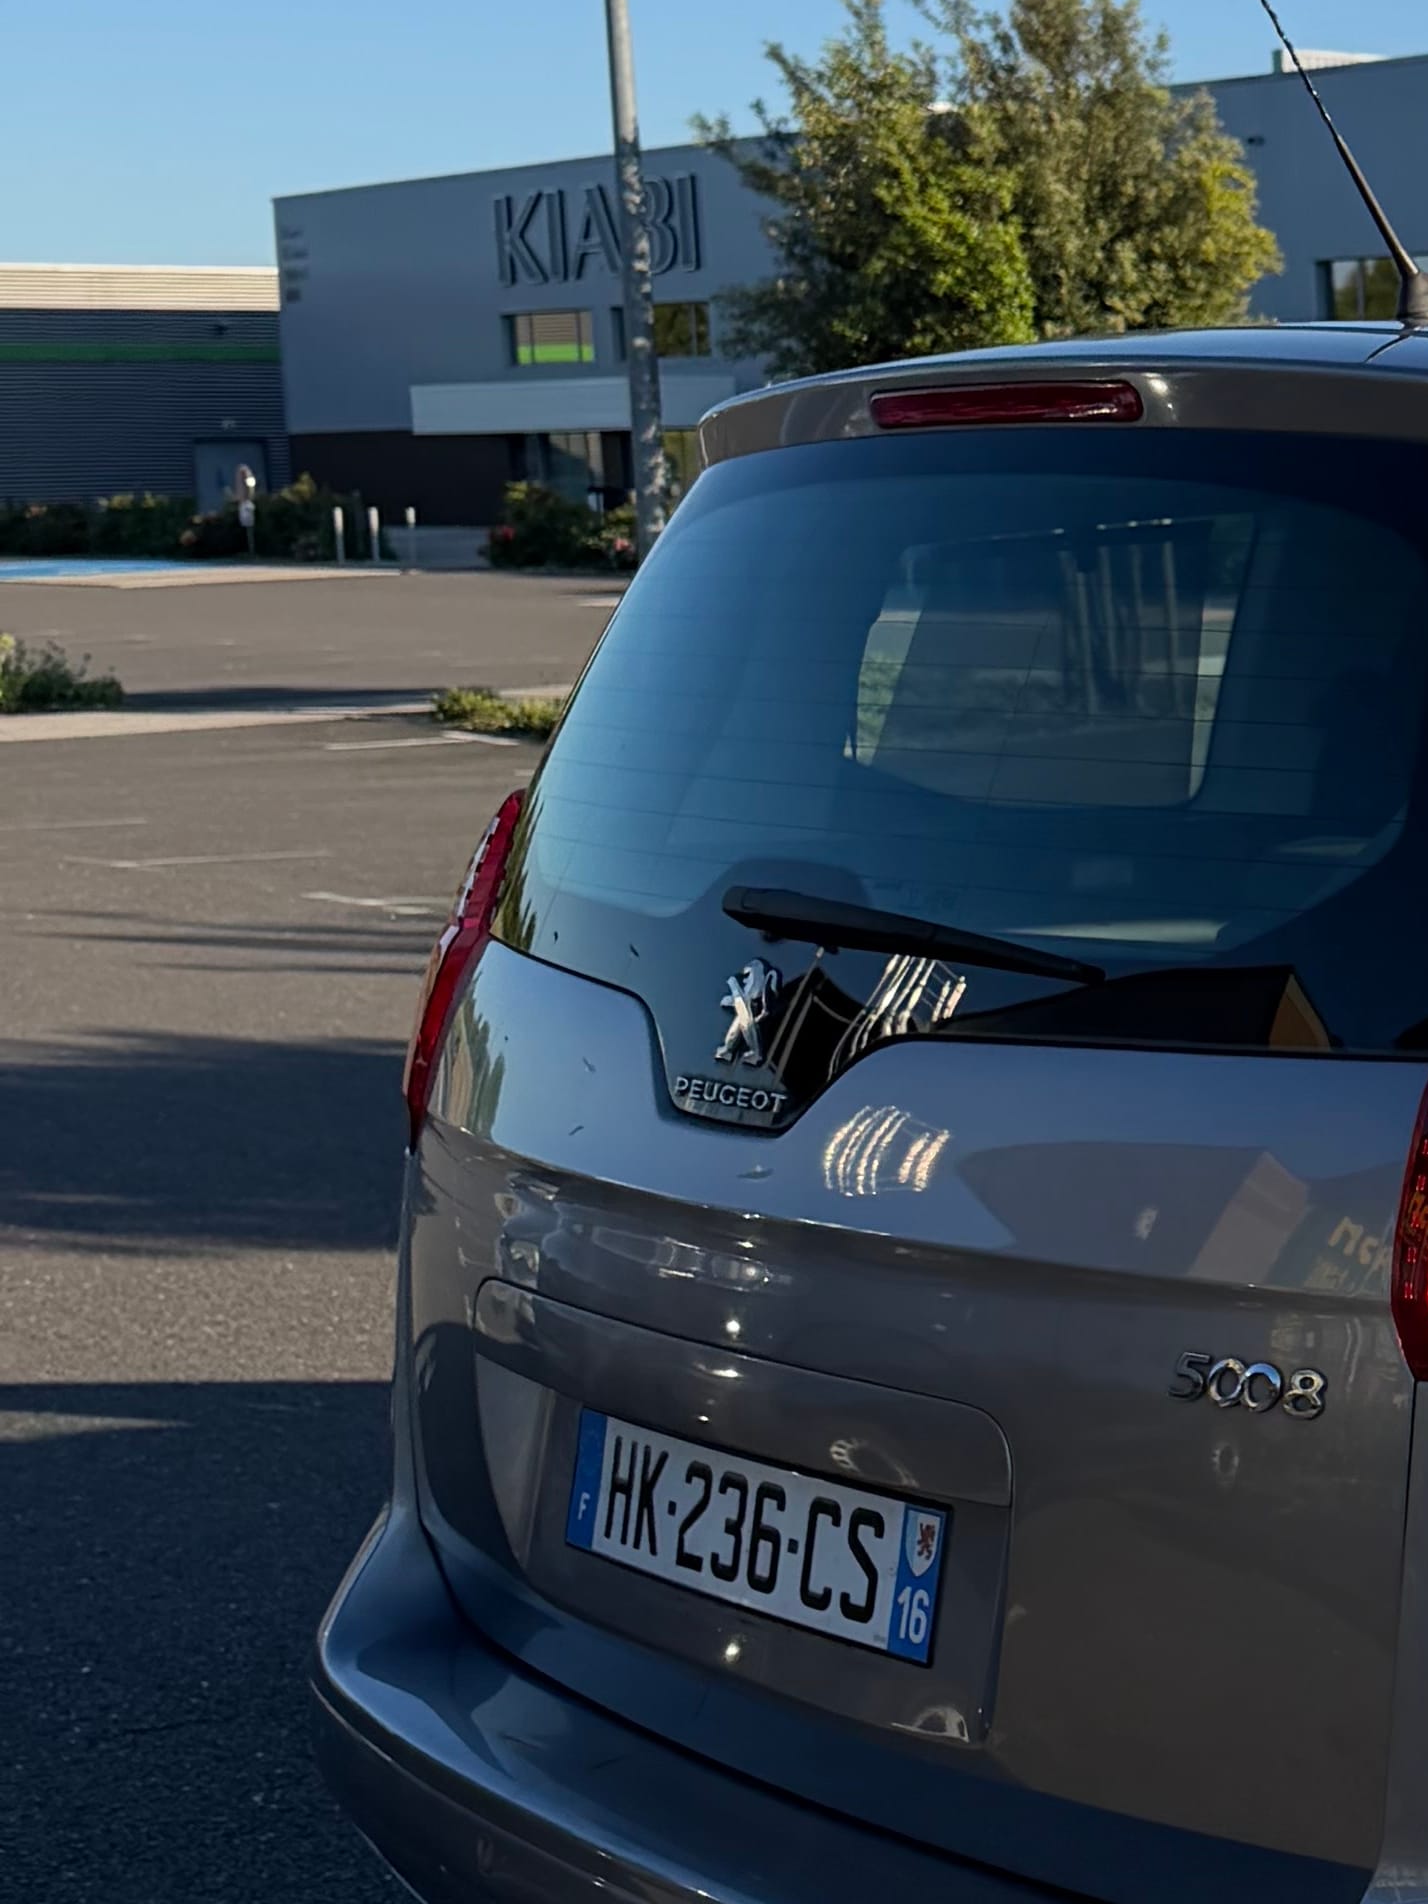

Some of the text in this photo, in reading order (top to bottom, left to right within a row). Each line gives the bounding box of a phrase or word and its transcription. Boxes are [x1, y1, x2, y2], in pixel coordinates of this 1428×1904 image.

[675, 1076, 787, 1113] PEUGEOT
[1167, 1351, 1328, 1420] 5008
[577, 1491, 591, 1521] F
[897, 1585, 931, 1645] 16
